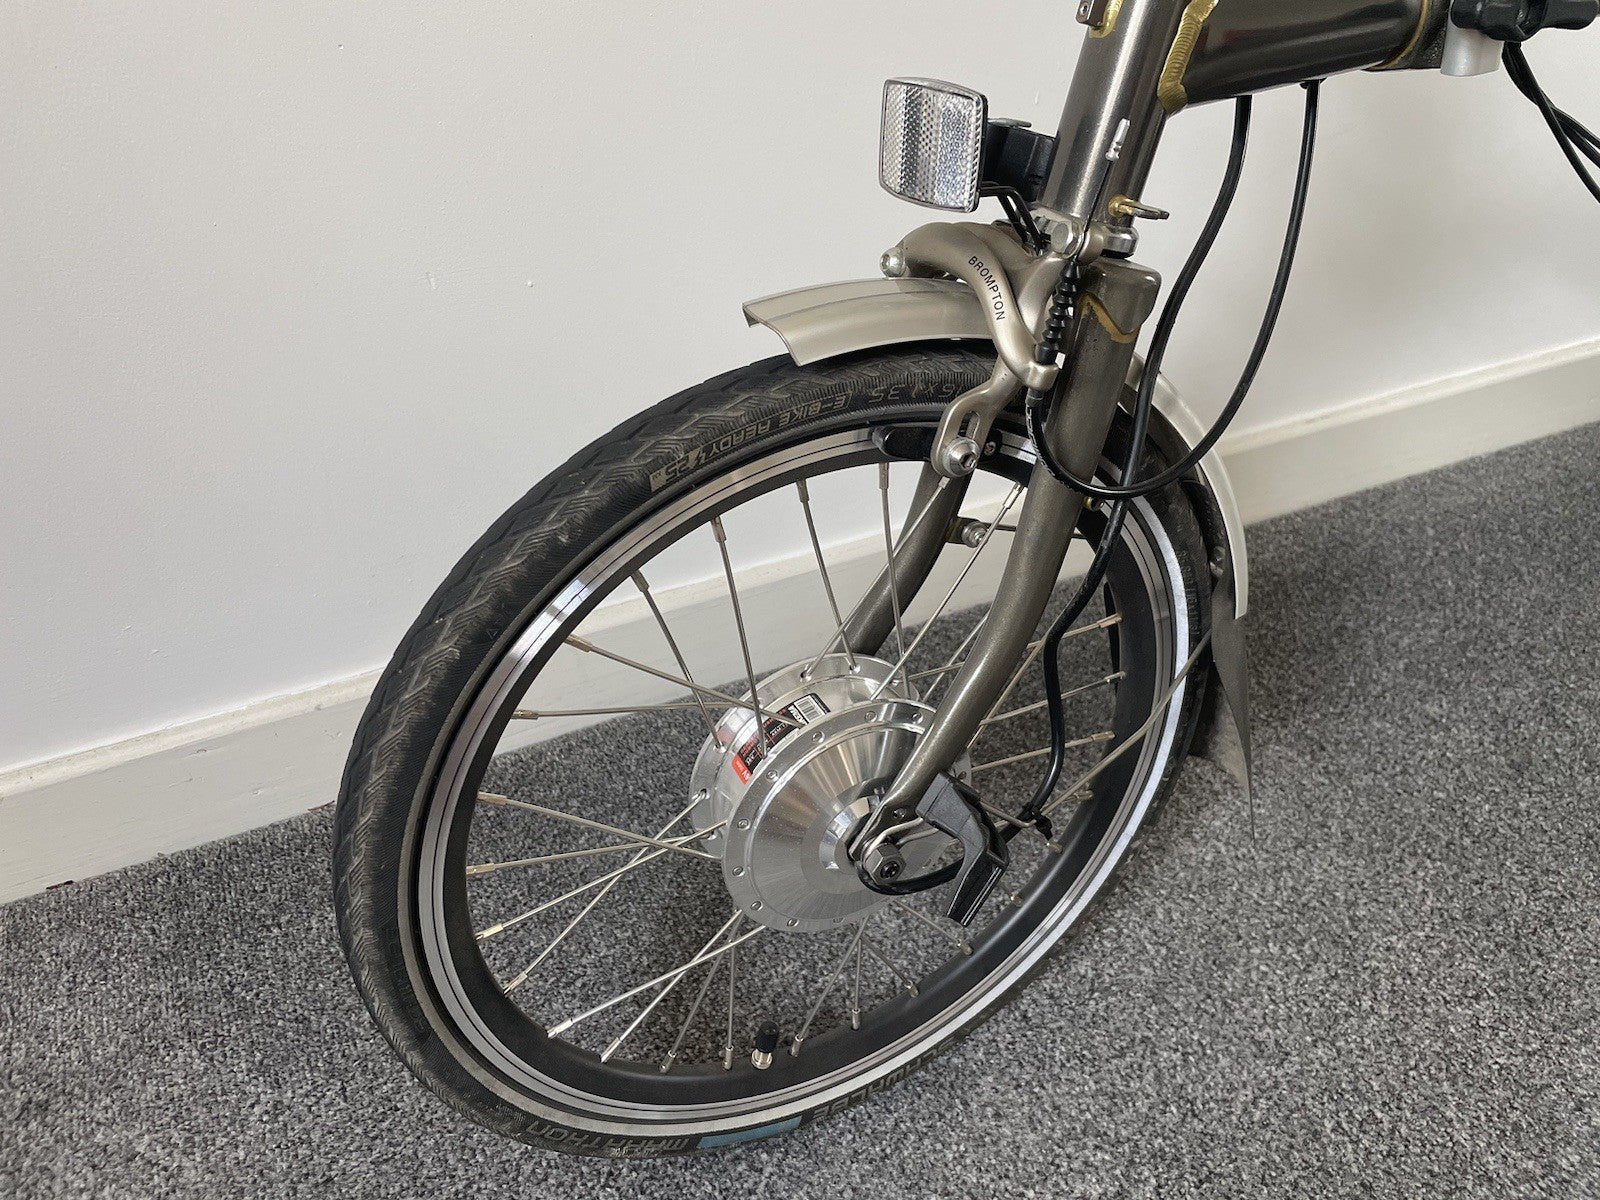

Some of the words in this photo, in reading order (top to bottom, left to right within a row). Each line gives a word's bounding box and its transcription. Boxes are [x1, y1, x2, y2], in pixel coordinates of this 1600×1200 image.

[968, 255, 1006, 321] BROMPTON
[779, 395, 846, 427] E-BIKE
[710, 419, 770, 457] READY
[526, 1120, 692, 1152] MARATHON
